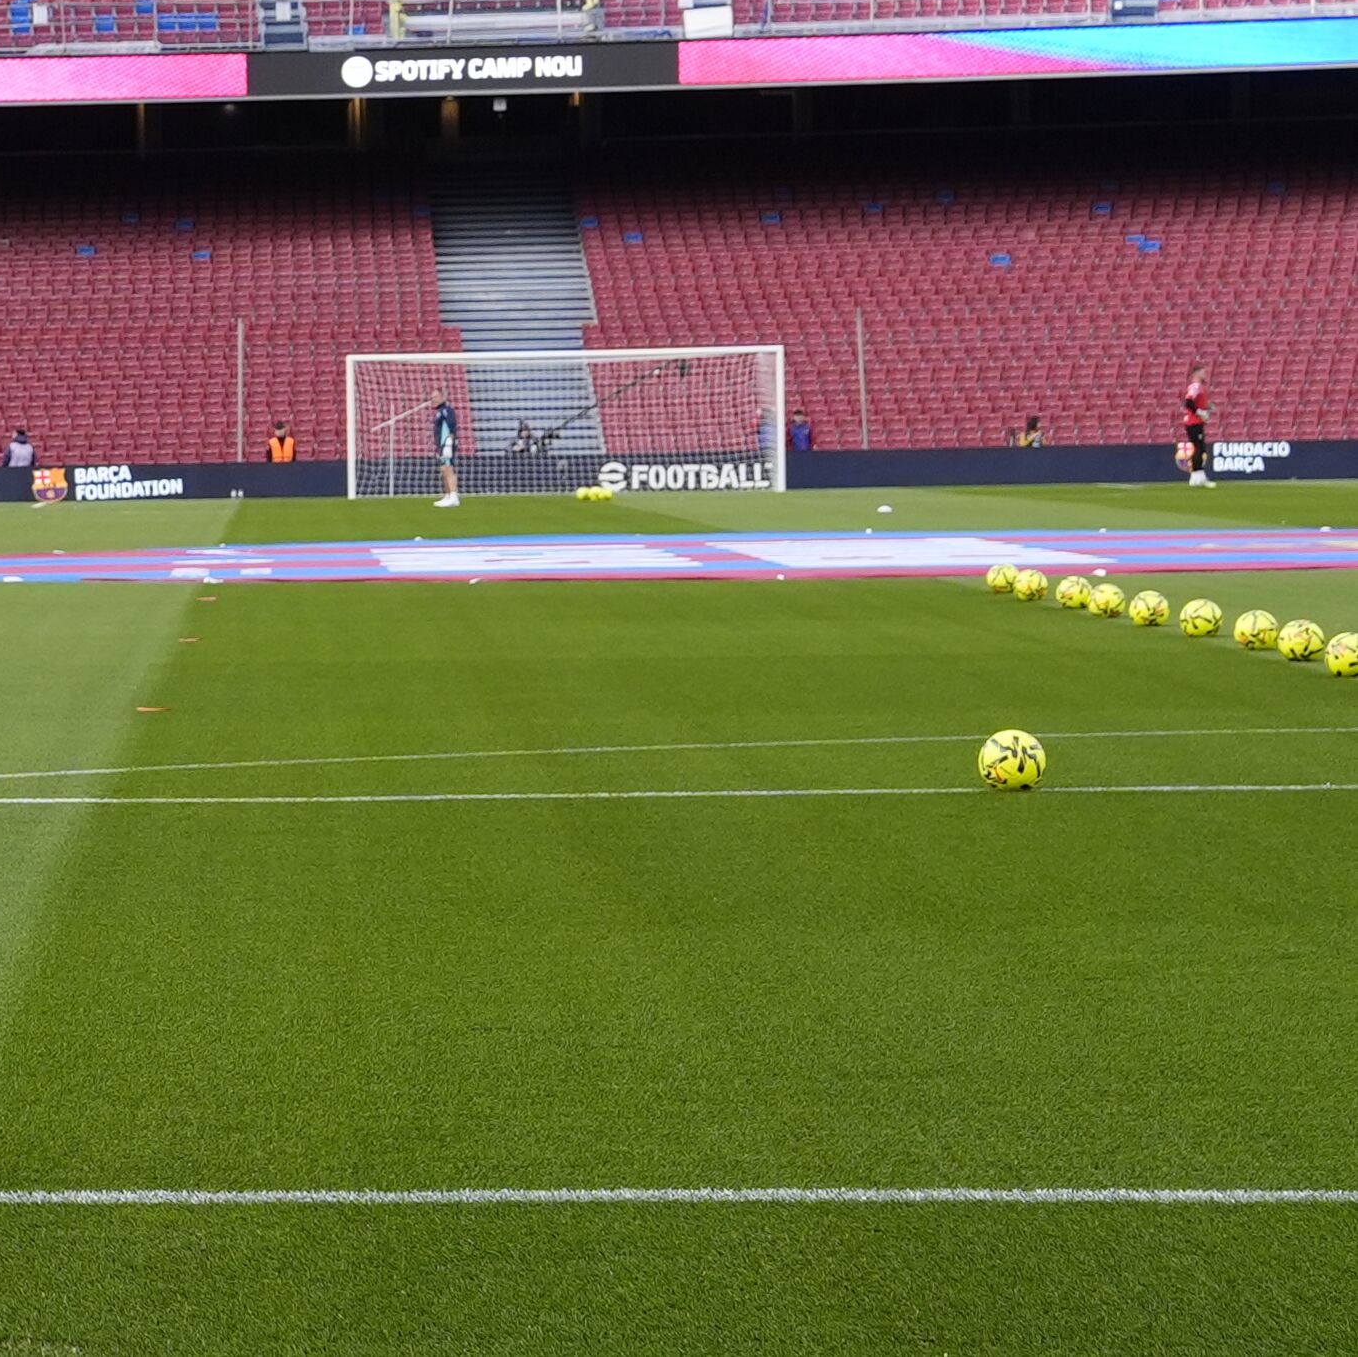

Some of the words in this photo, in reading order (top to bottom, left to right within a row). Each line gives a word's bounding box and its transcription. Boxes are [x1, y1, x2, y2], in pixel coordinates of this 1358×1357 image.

[374, 58, 466, 82] SPOTIFY
[467, 56, 532, 79] CAMP
[534, 55, 583, 78] NOU
[74, 465, 132, 484] BARÇA
[1212, 456, 1265, 473] BARÇA
[75, 478, 183, 501] FOUNDATION
